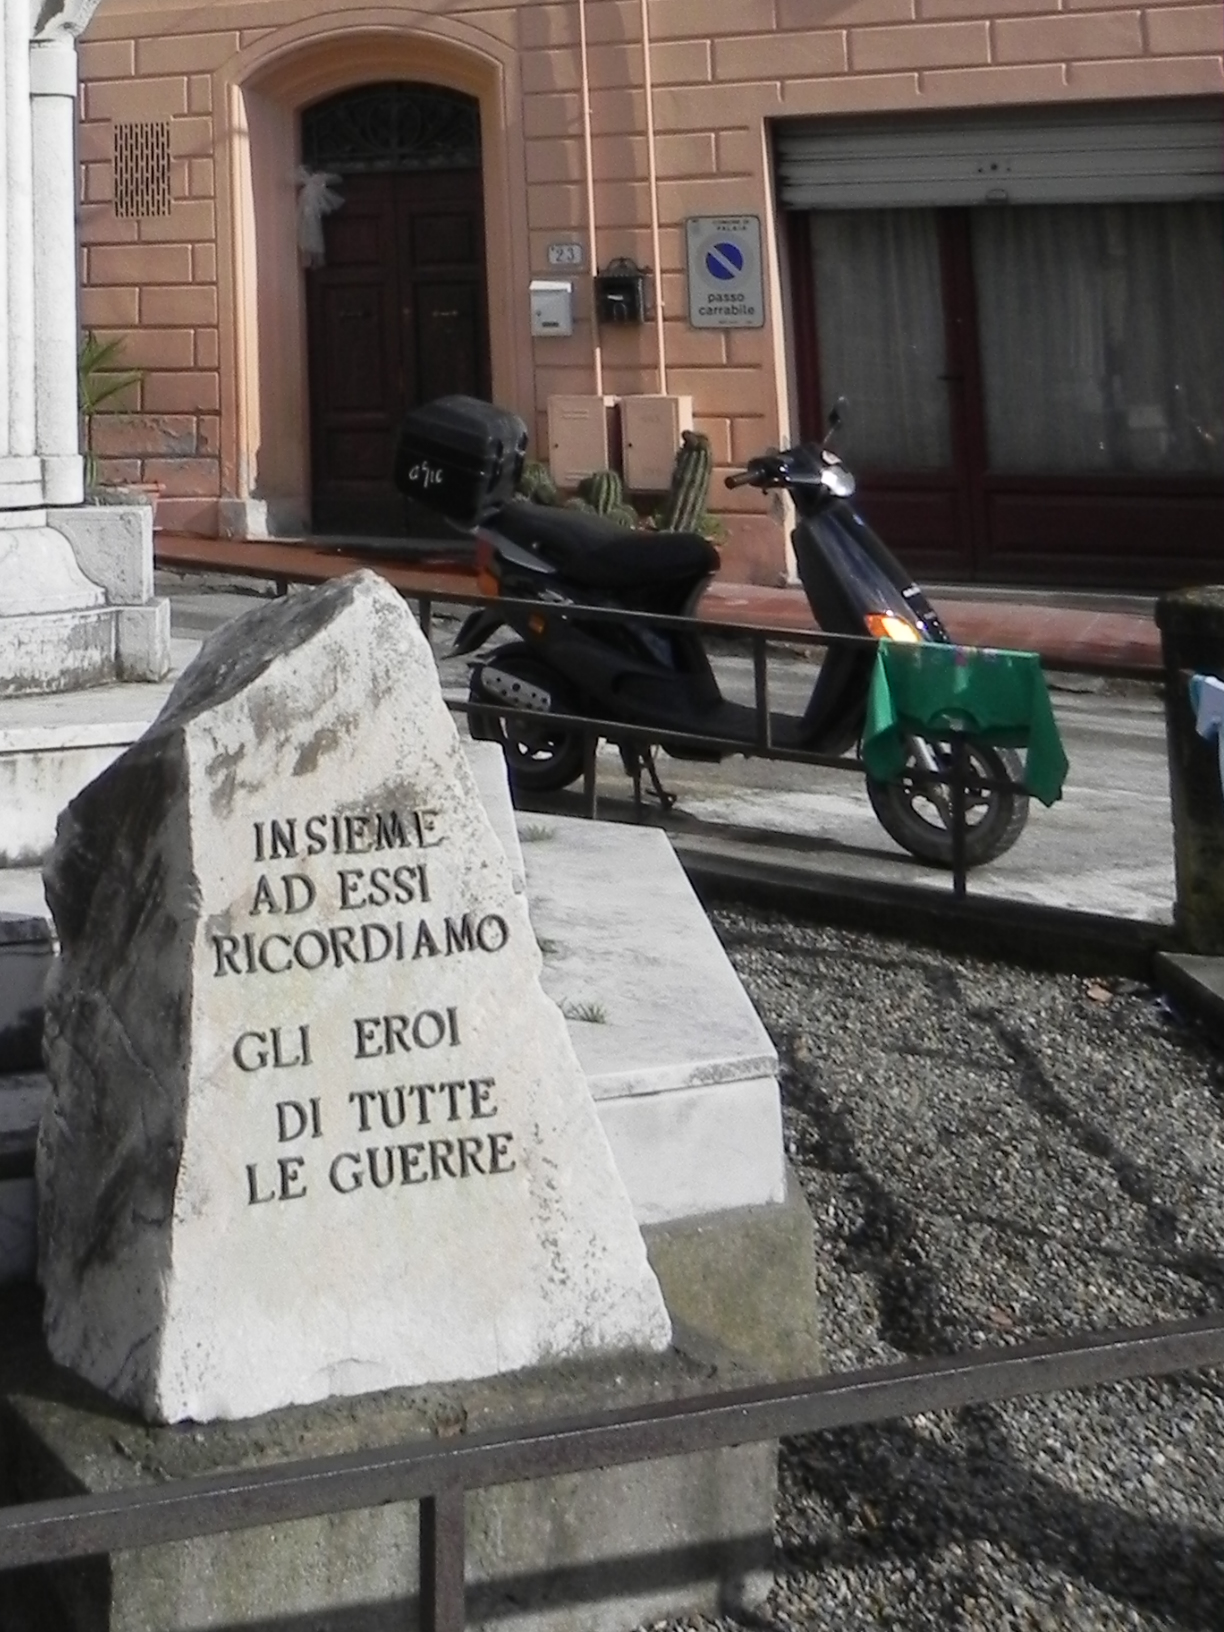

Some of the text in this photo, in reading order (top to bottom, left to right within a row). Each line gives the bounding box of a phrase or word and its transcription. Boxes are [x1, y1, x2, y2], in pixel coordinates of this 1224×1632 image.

[698, 304, 755, 316] carrabile
[707, 293, 745, 304] passo
[253, 808, 444, 862] INSIEME
[249, 863, 431, 916] AD ESSI
[212, 913, 510, 978] RICORDIAMO
[232, 1006, 462, 1073] GLI EROI
[275, 1077, 499, 1143] DI TUTTE
[245, 1131, 517, 1206] LE GUERRE
